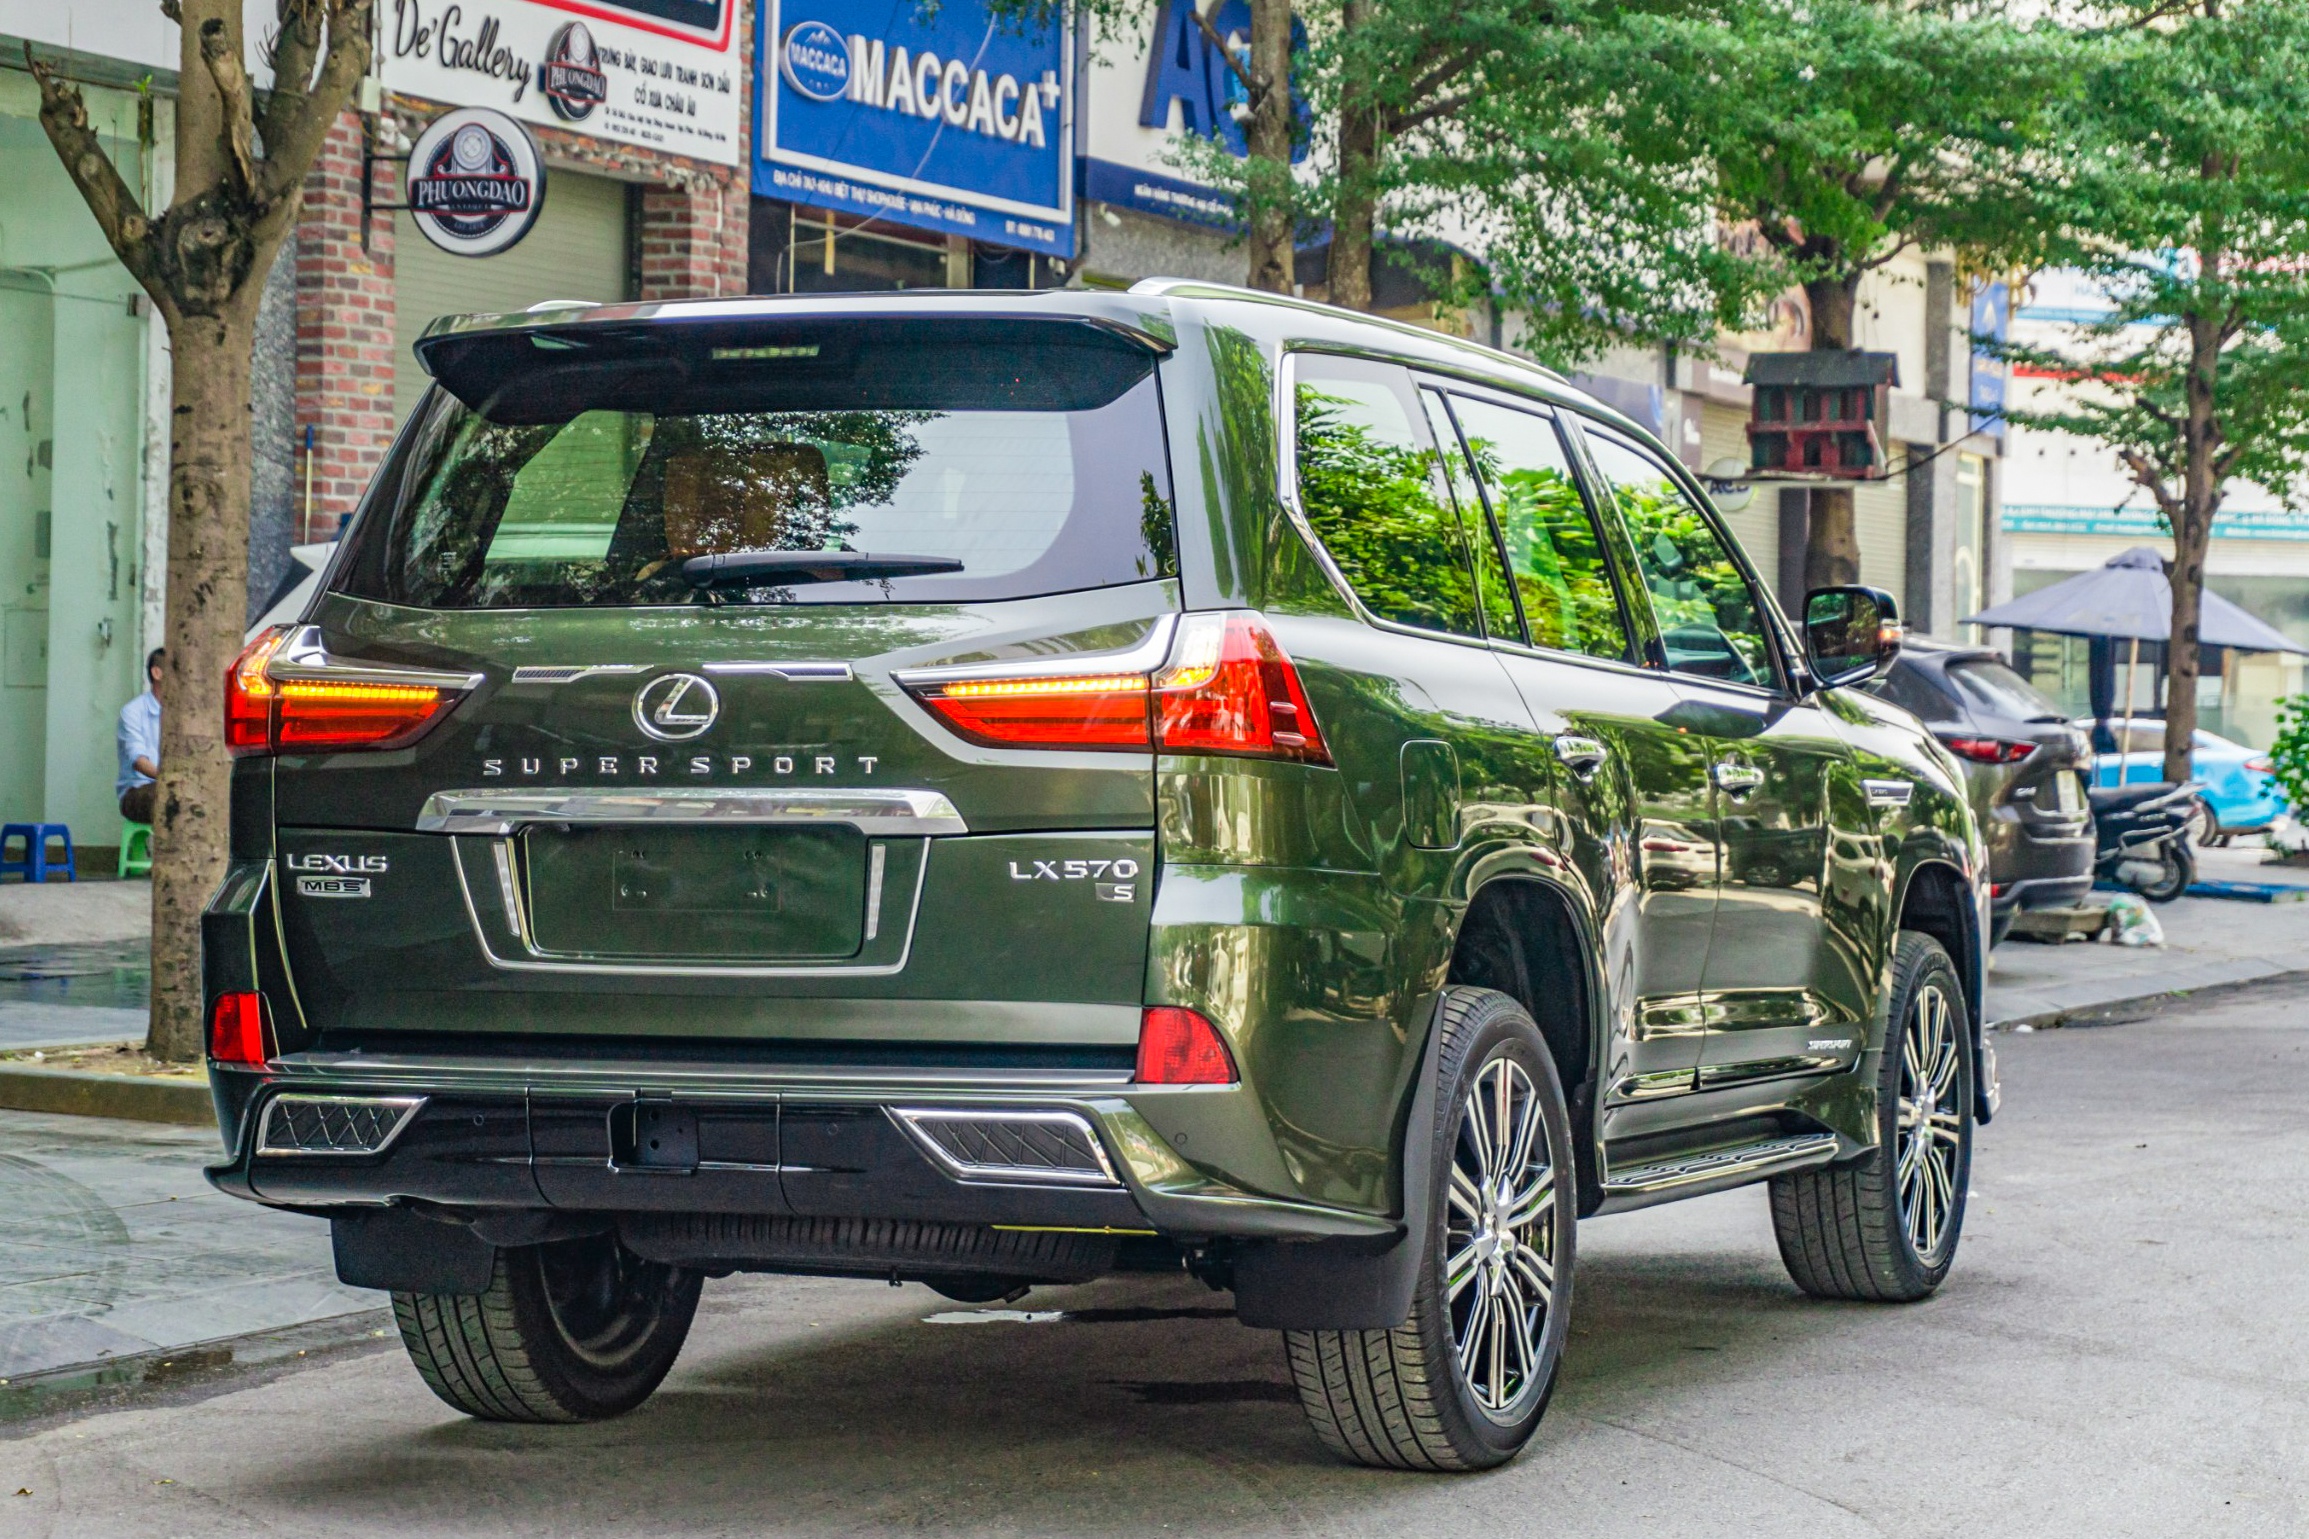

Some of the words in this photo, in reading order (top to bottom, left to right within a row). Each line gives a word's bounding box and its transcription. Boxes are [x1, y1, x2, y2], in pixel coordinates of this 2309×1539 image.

[791, 42, 847, 77] MACCACA
[482, 757, 658, 776] SUPER
[690, 756, 878, 775] SPORT
[286, 853, 387, 873] LEXUS
[304, 881, 361, 892] MBS
